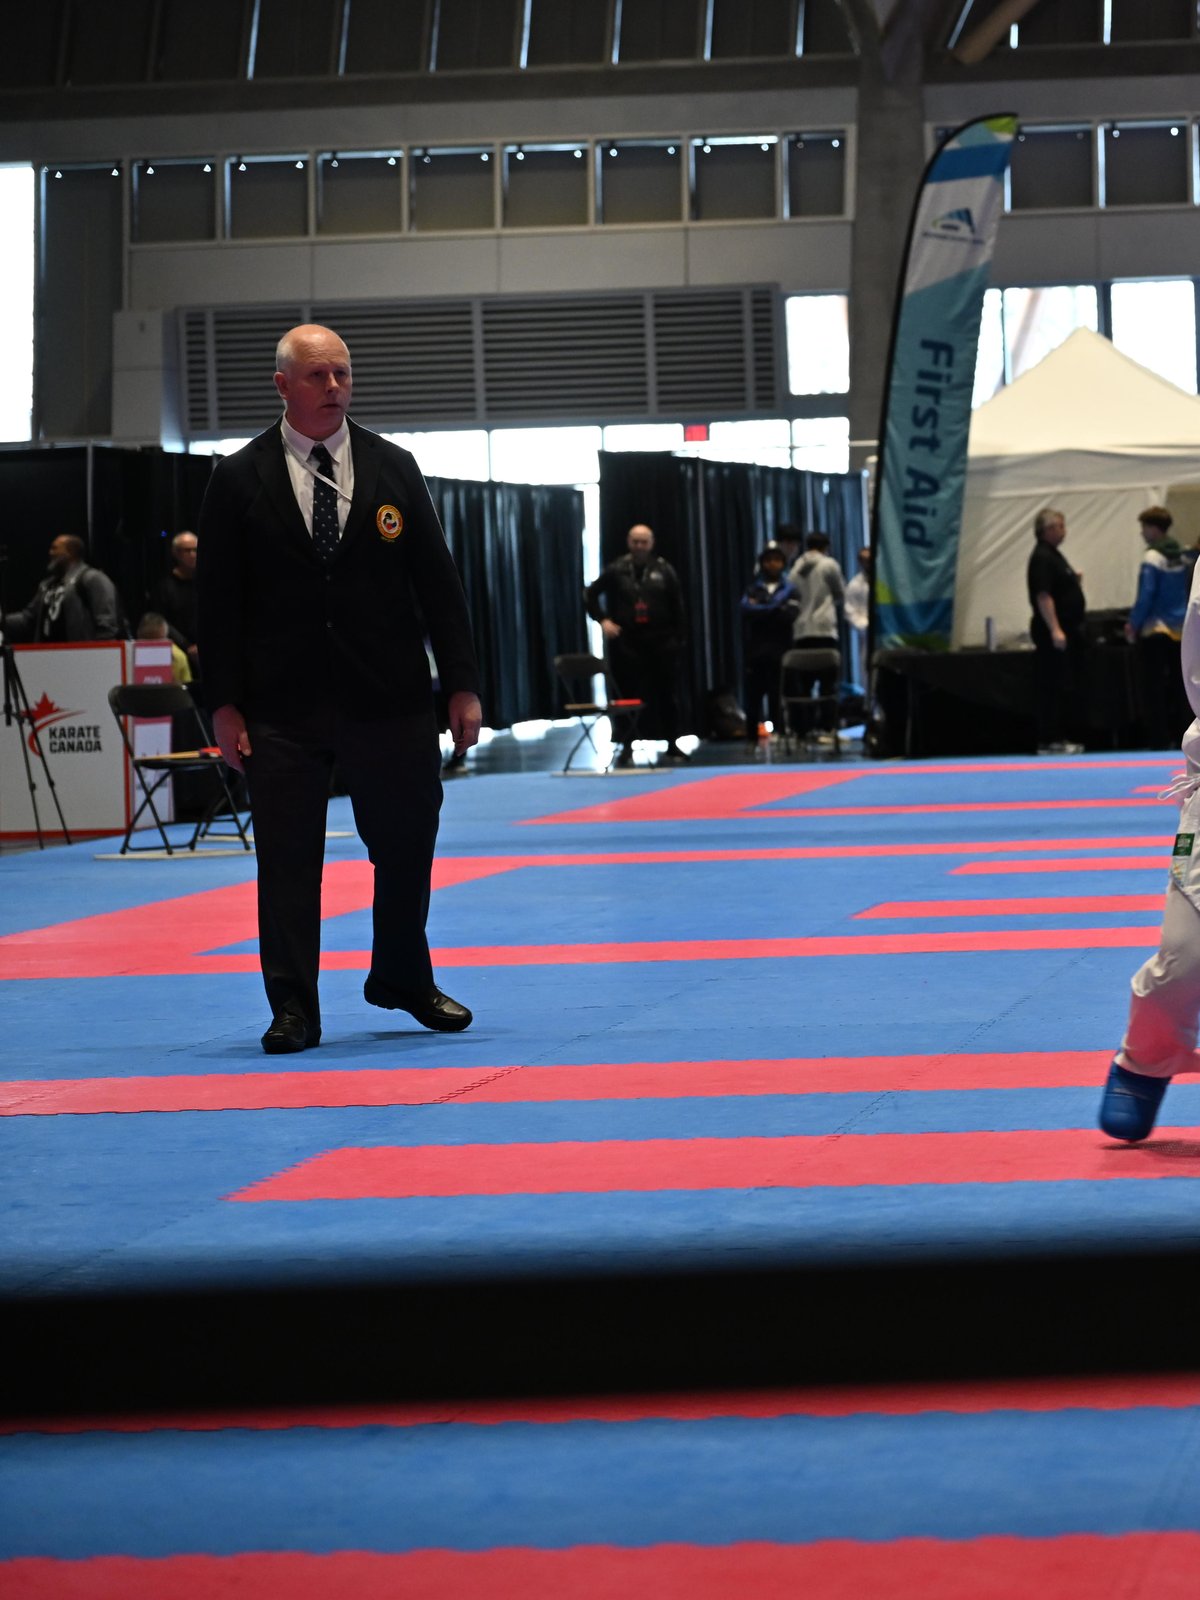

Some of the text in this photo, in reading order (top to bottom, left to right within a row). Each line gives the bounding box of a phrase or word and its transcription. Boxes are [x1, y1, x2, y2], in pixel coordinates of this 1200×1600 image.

[903, 339, 954, 549] First Aid
[49, 725, 101, 739] KARATE
[49, 740, 102, 753] CANADA
